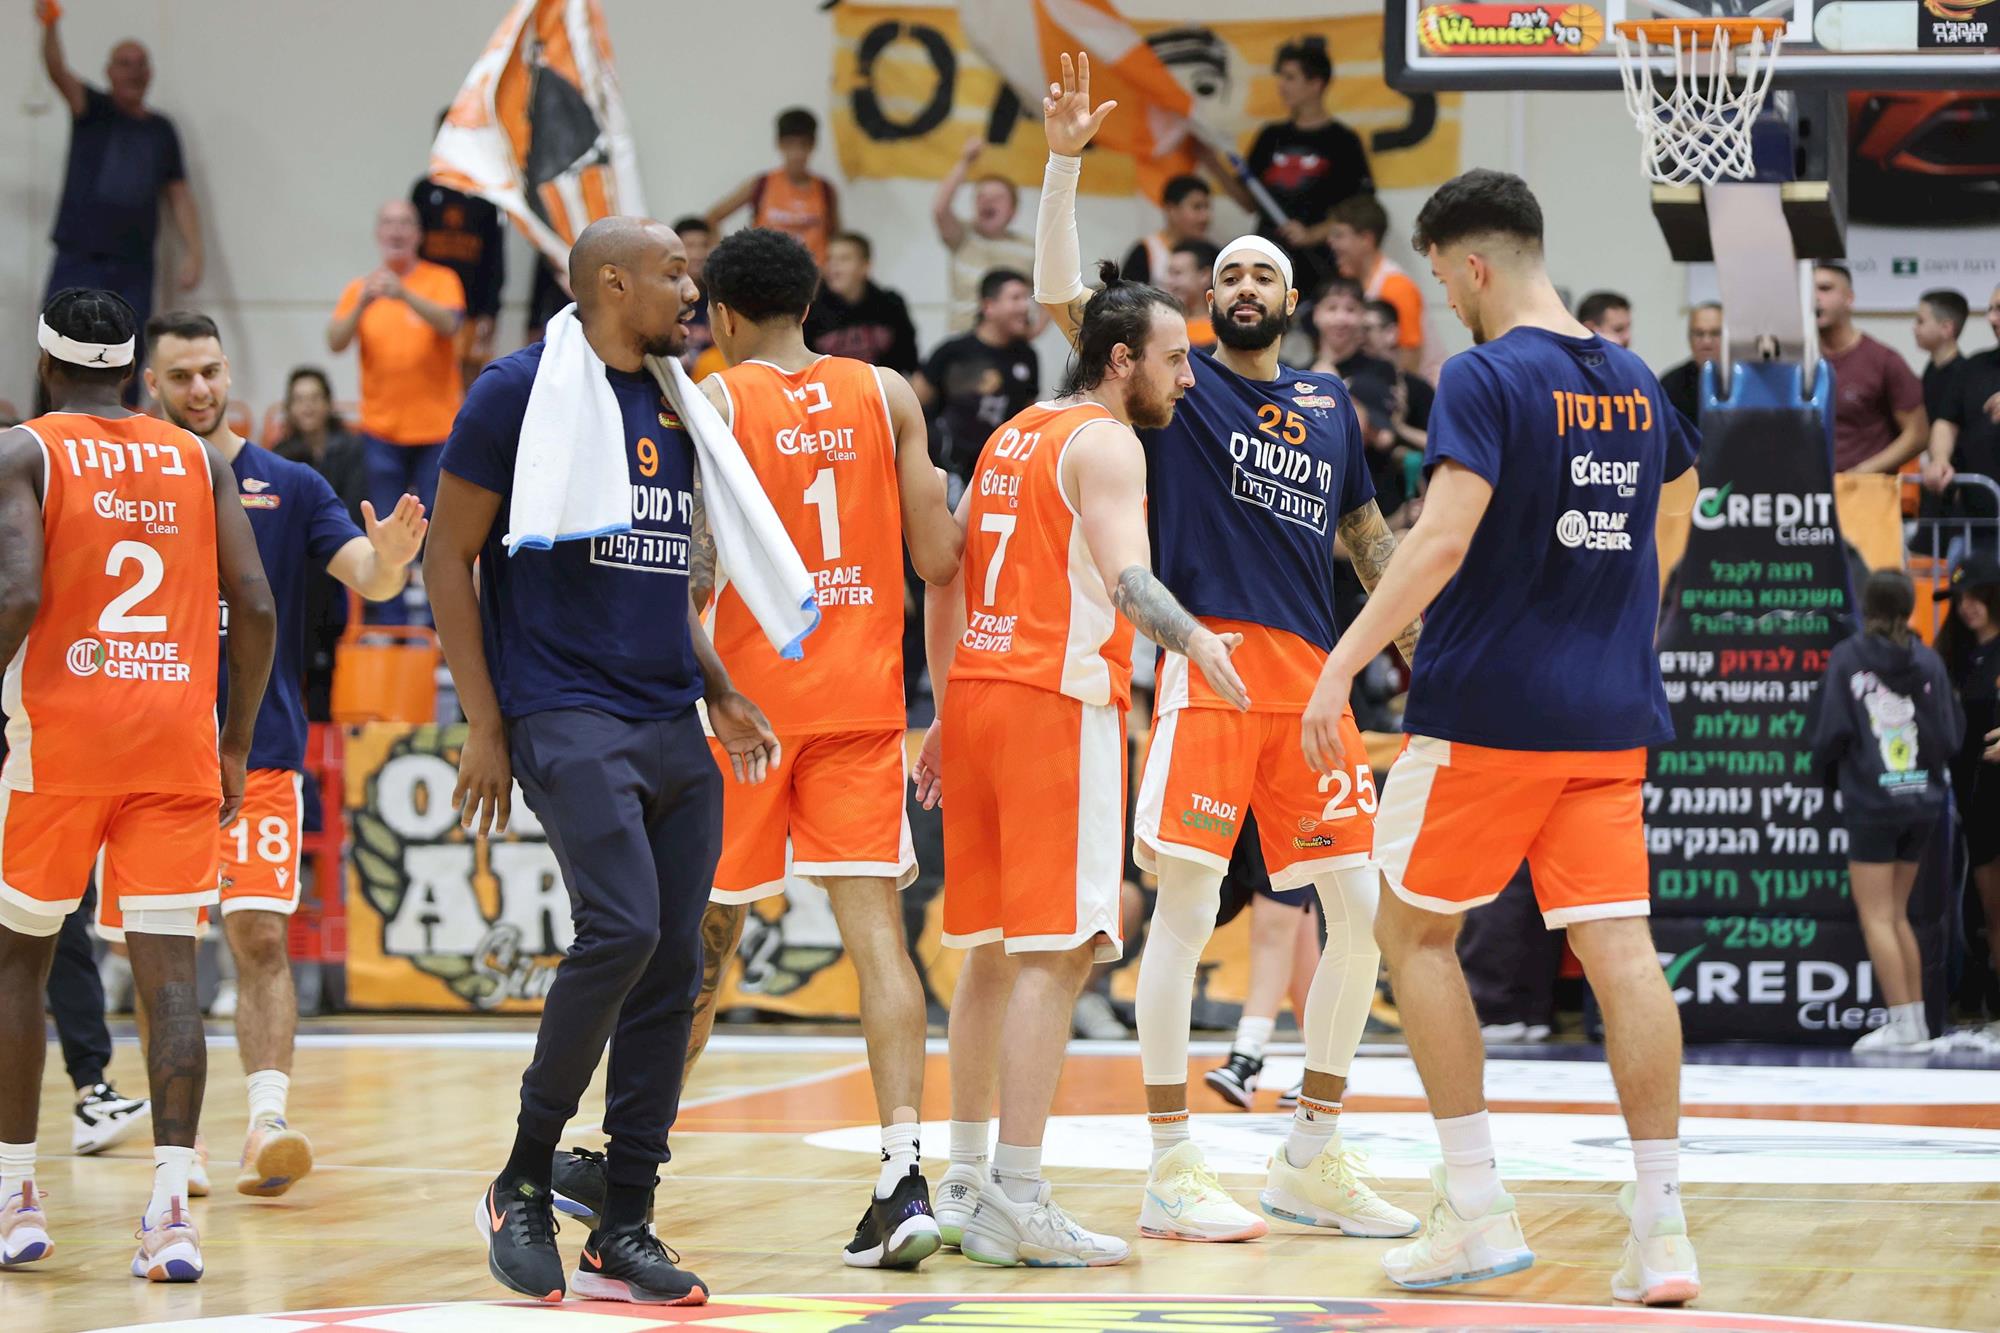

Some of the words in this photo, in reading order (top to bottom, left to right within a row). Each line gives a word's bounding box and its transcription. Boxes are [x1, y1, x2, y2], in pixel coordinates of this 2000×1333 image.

[1438, 16, 1552, 45] Winner
[1553, 22, 1582, 45] סל
[1257, 403, 1307, 445] 25
[1552, 388, 1653, 436] לוינסון
[776, 426, 855, 455] CREDIT
[826, 450, 857, 462] Clean
[63, 438, 186, 479] ביוקנן
[636, 437, 659, 477] 9
[1229, 431, 1312, 484] מוטורס
[1570, 452, 1640, 486] CREDIT
[980, 466, 1022, 496] CREDI
[1316, 460, 1332, 494] חי
[93, 490, 176, 522] CREDIT
[632, 484, 673, 523] מוט
[803, 467, 841, 561] 1
[1279, 490, 1324, 525] ציונה
[1692, 484, 1832, 530] CREDIT
[145, 522, 179, 534] Clean
[1775, 526, 1834, 546] Clean
[642, 539, 687, 565] ציונה
[980, 512, 1017, 607] 7
[98, 540, 167, 632] 2
[809, 566, 862, 587] TRADE
[1710, 559, 1762, 584] לקבל
[970, 610, 1017, 633] TRADE
[105, 639, 179, 661] TRADE
[1659, 650, 1714, 678] קודם
[1720, 646, 1796, 678] לבדוק
[104, 660, 190, 682] CENTER
[1691, 680, 1785, 703] האשראי
[1693, 709, 1761, 739] עלות
[1768, 710, 1806, 739] לא
[1657, 751, 1786, 776] התחייבות
[1191, 793, 1237, 822] TRADE
[1317, 764, 1378, 822] 25
[1668, 786, 1752, 815] נותנת
[1760, 782, 1824, 821] קלין
[229, 815, 291, 864] 18
[1766, 822, 1820, 855] מול
[1657, 868, 1739, 899] חינם
[384, 844, 576, 955] AR
[1657, 952, 1873, 1004] REDI
[1797, 1001, 1889, 1030] Clea
